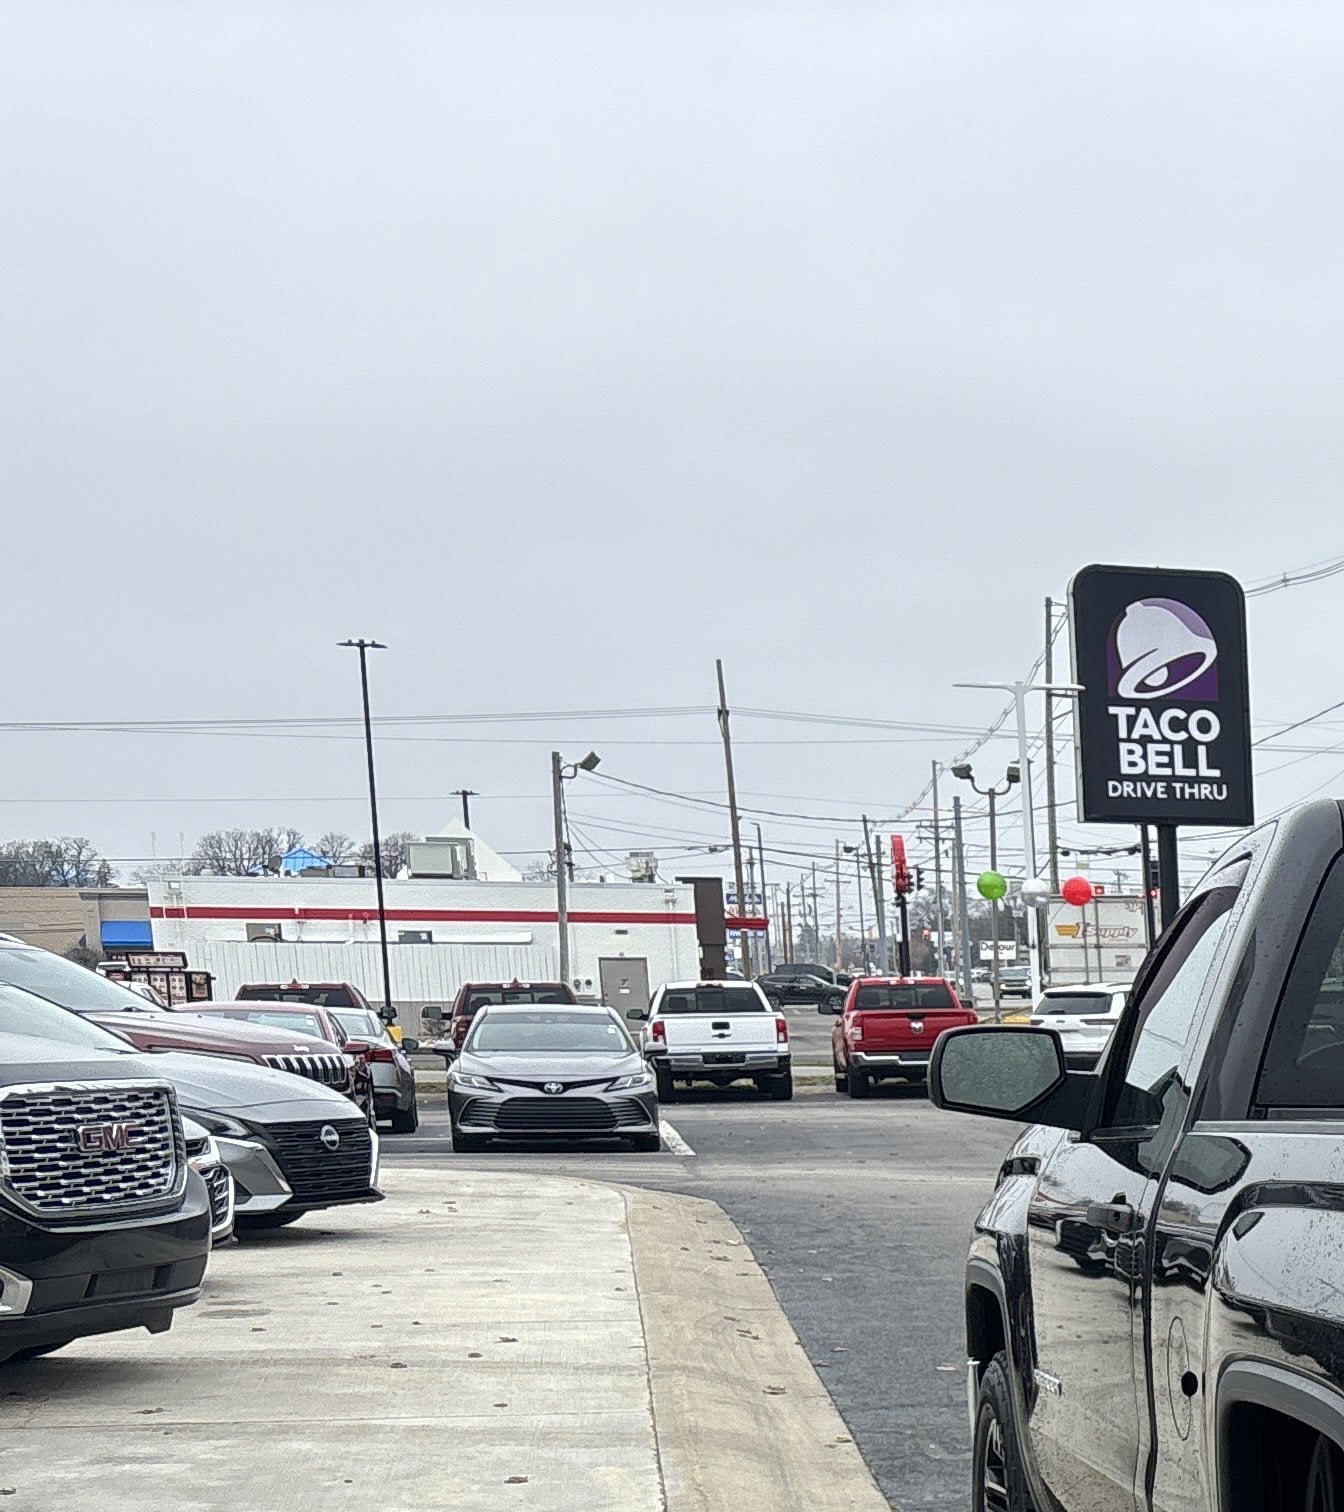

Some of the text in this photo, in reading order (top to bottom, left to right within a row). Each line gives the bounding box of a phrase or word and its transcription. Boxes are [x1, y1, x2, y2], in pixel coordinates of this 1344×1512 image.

[1107, 705, 1221, 742] TACO
[1118, 741, 1221, 778] BELL
[1107, 780, 1228, 801] DRIVE THRU
[78, 1122, 142, 1151] GMC
